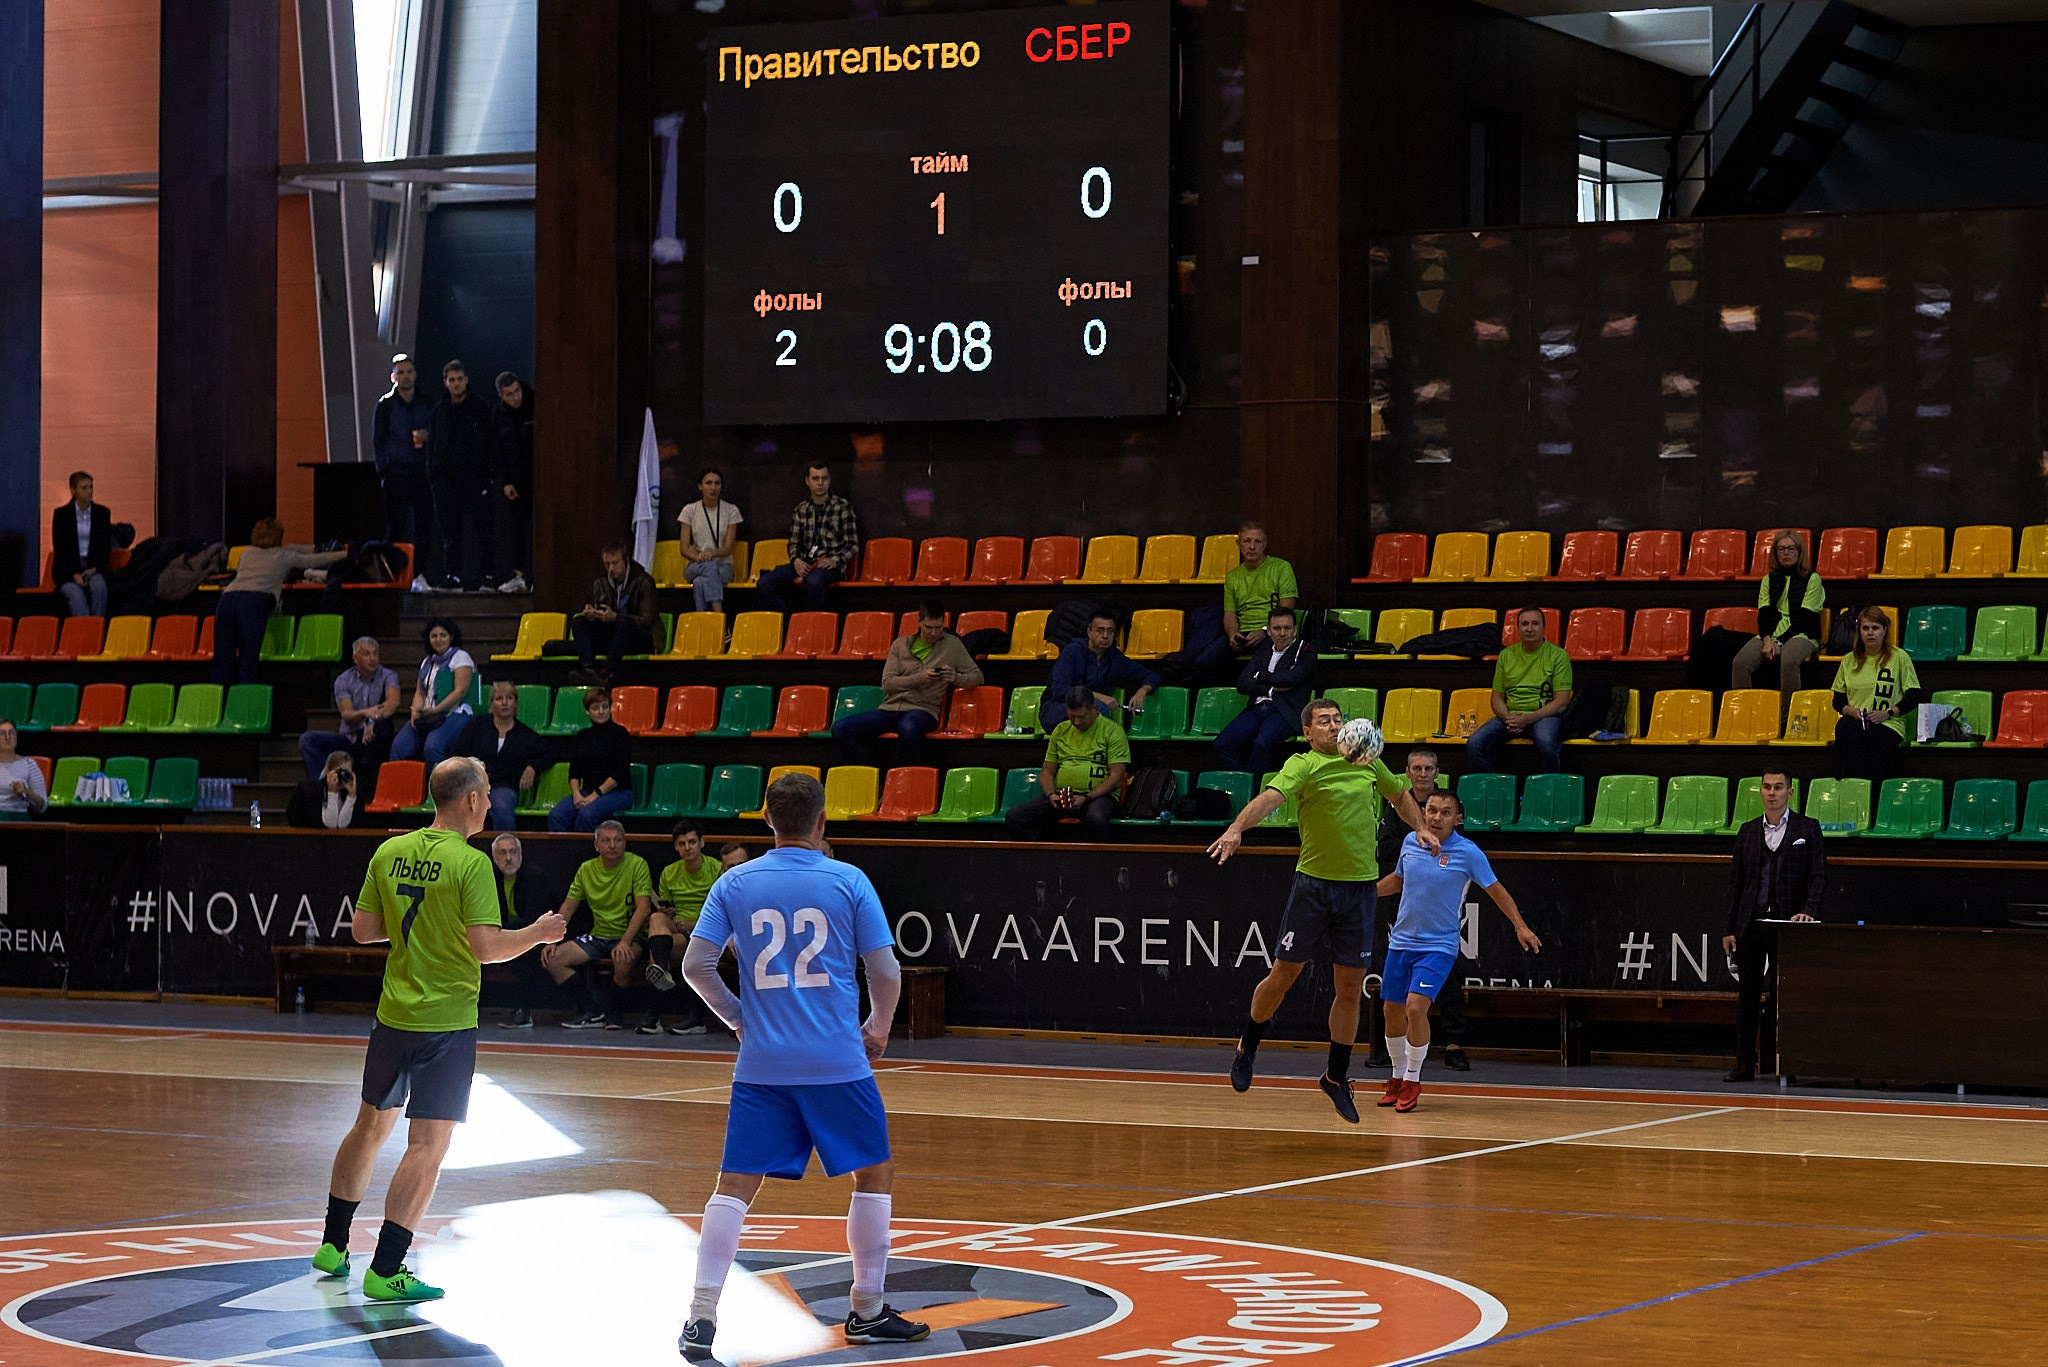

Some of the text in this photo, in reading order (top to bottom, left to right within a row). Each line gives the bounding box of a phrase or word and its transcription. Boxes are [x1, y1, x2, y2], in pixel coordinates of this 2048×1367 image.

[718, 40, 981, 88] Правительство
[1025, 21, 1132, 63] СБЕР
[910, 151, 969, 175] тайм
[773, 182, 803, 233] 0
[930, 191, 945, 235] 1
[1080, 166, 1112, 219] 0
[753, 288, 823, 318] фолы
[1057, 277, 1132, 307] фолы
[775, 329, 797, 366] 2
[884, 320, 993, 374] 9:08
[1083, 318, 1107, 356] 0
[127, 890, 356, 938] #NOVAA
[396, 883, 425, 949] 7
[751, 907, 830, 990] 22
[895, 911, 1273, 969] OVAARENA
[1281, 931, 1295, 952] 4
[1182, 1272, 1383, 1333] HARD
